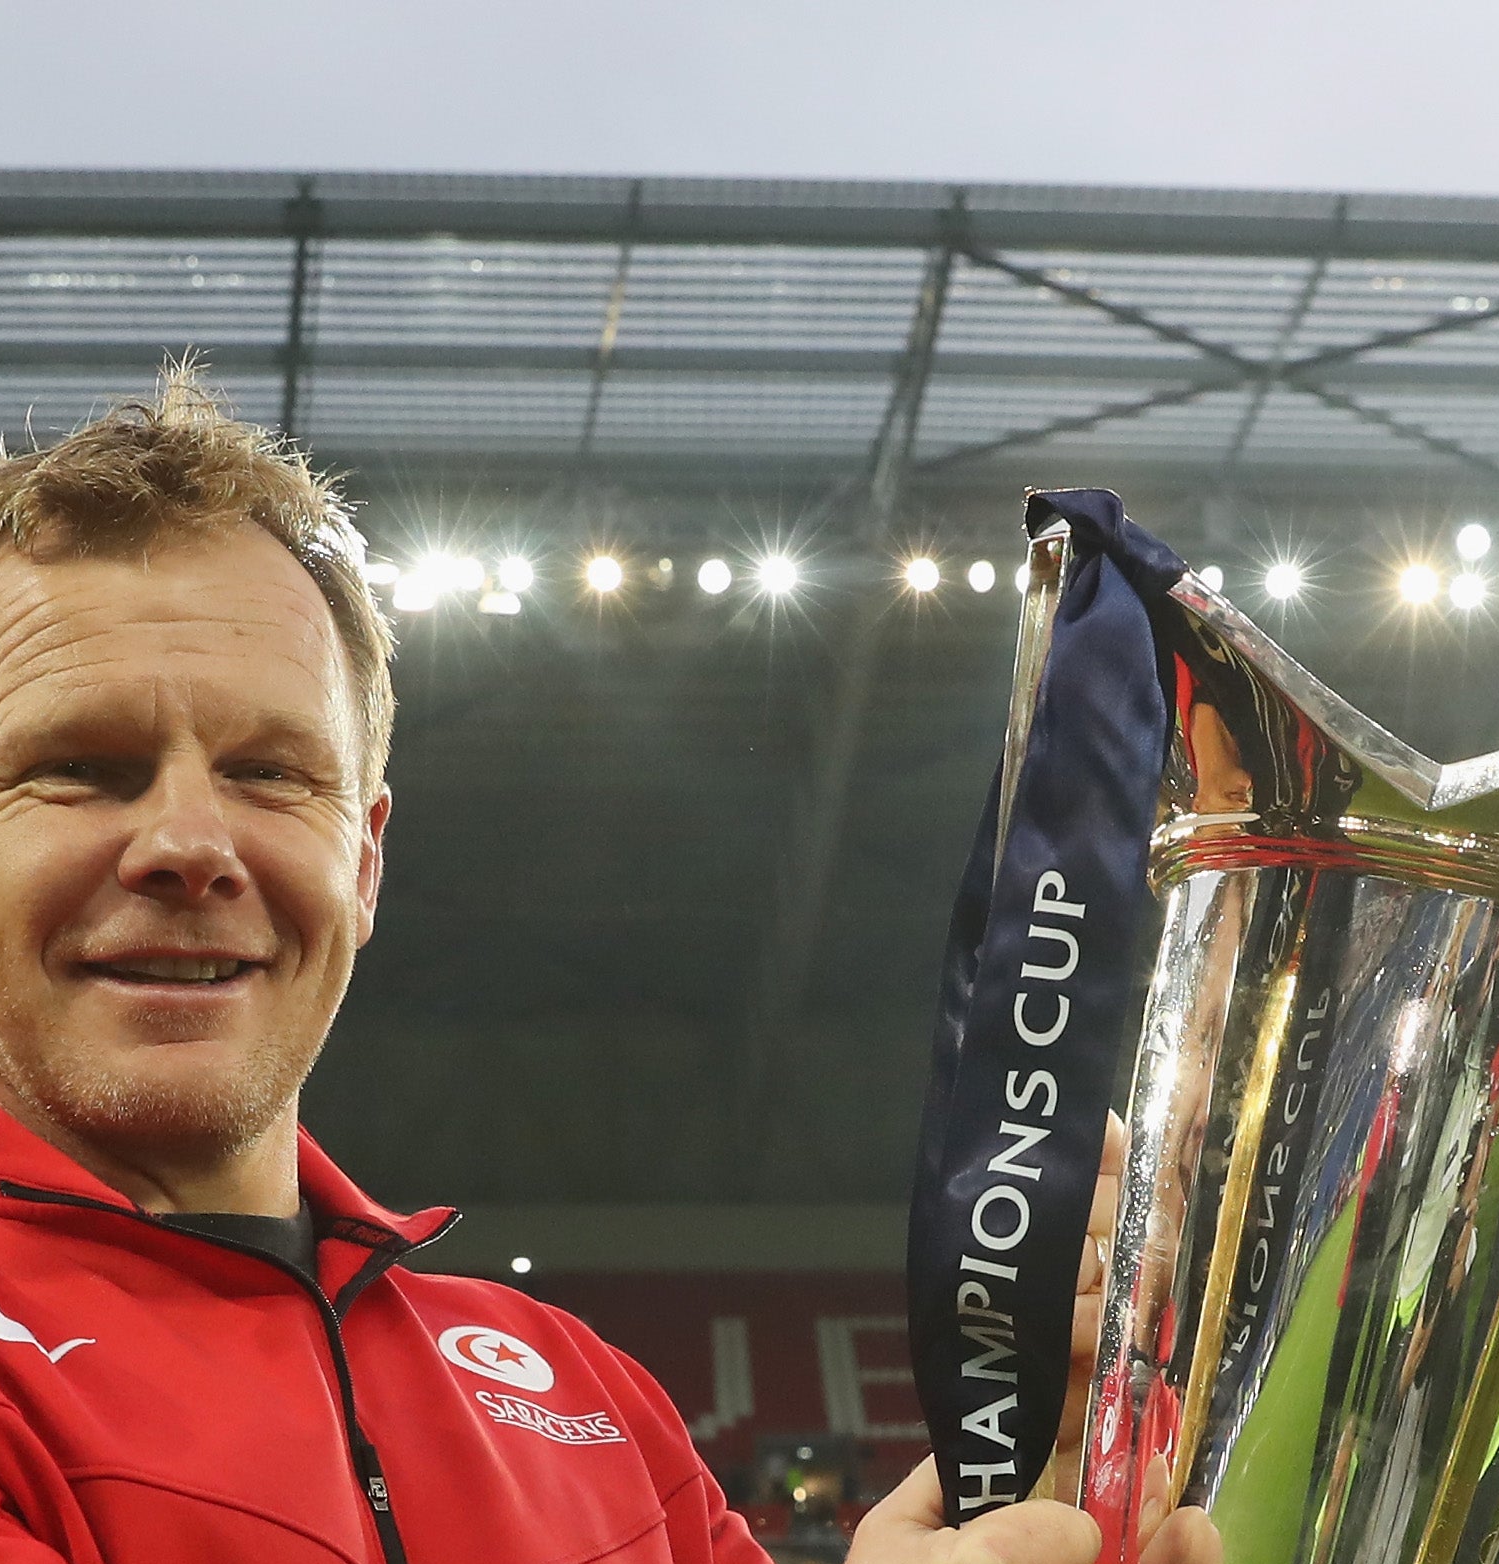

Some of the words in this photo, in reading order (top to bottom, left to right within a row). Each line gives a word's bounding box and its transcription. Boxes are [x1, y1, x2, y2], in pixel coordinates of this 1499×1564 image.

[957, 1069, 1059, 1512] HAMPIONS
[1013, 869, 1087, 1048] CUP
[475, 1390, 622, 1442] SARACENS
